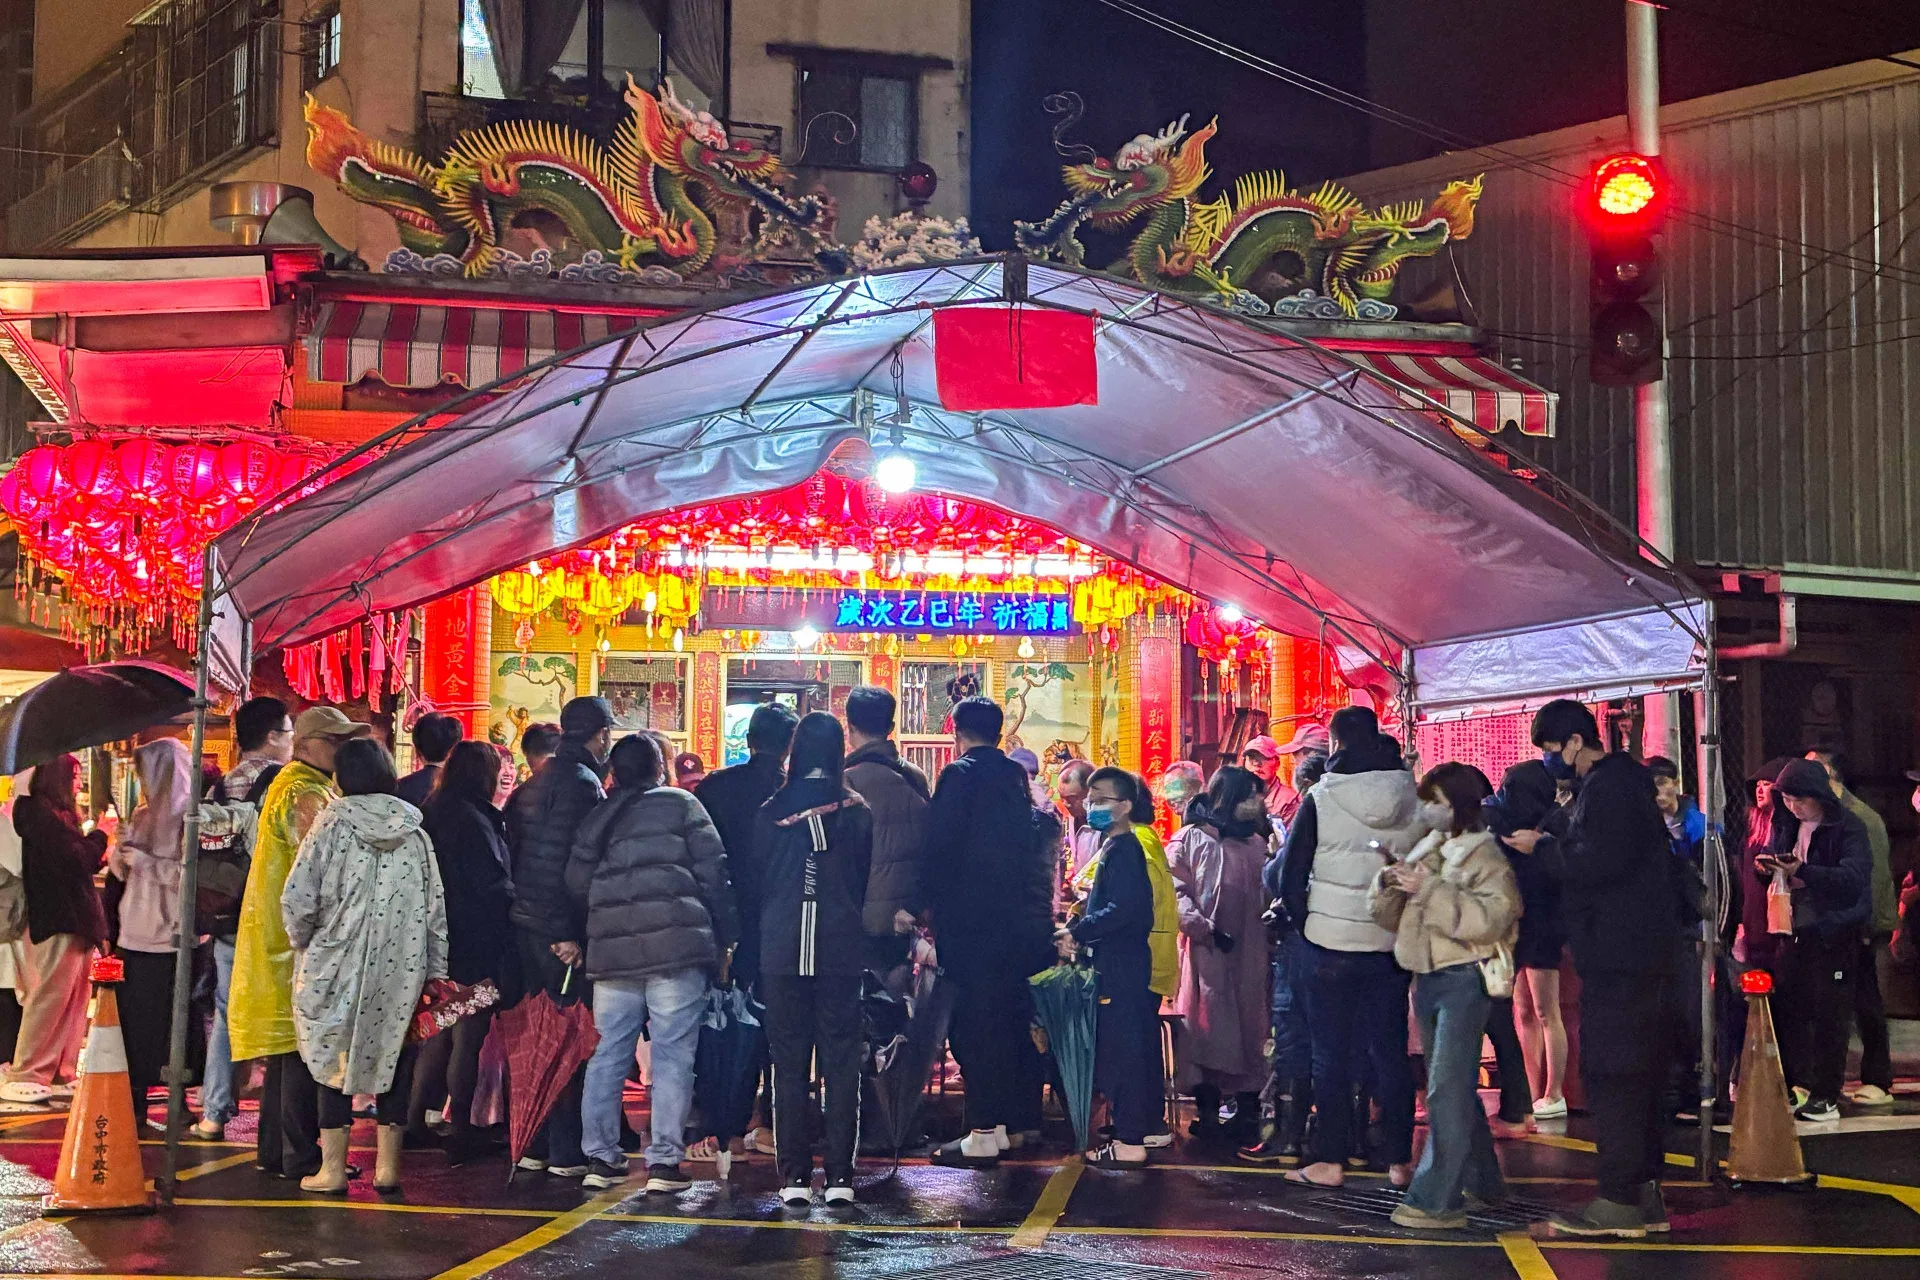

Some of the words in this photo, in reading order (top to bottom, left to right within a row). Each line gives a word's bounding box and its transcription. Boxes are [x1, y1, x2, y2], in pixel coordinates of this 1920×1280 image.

[92, 1114, 108, 1184] 台中市政府
